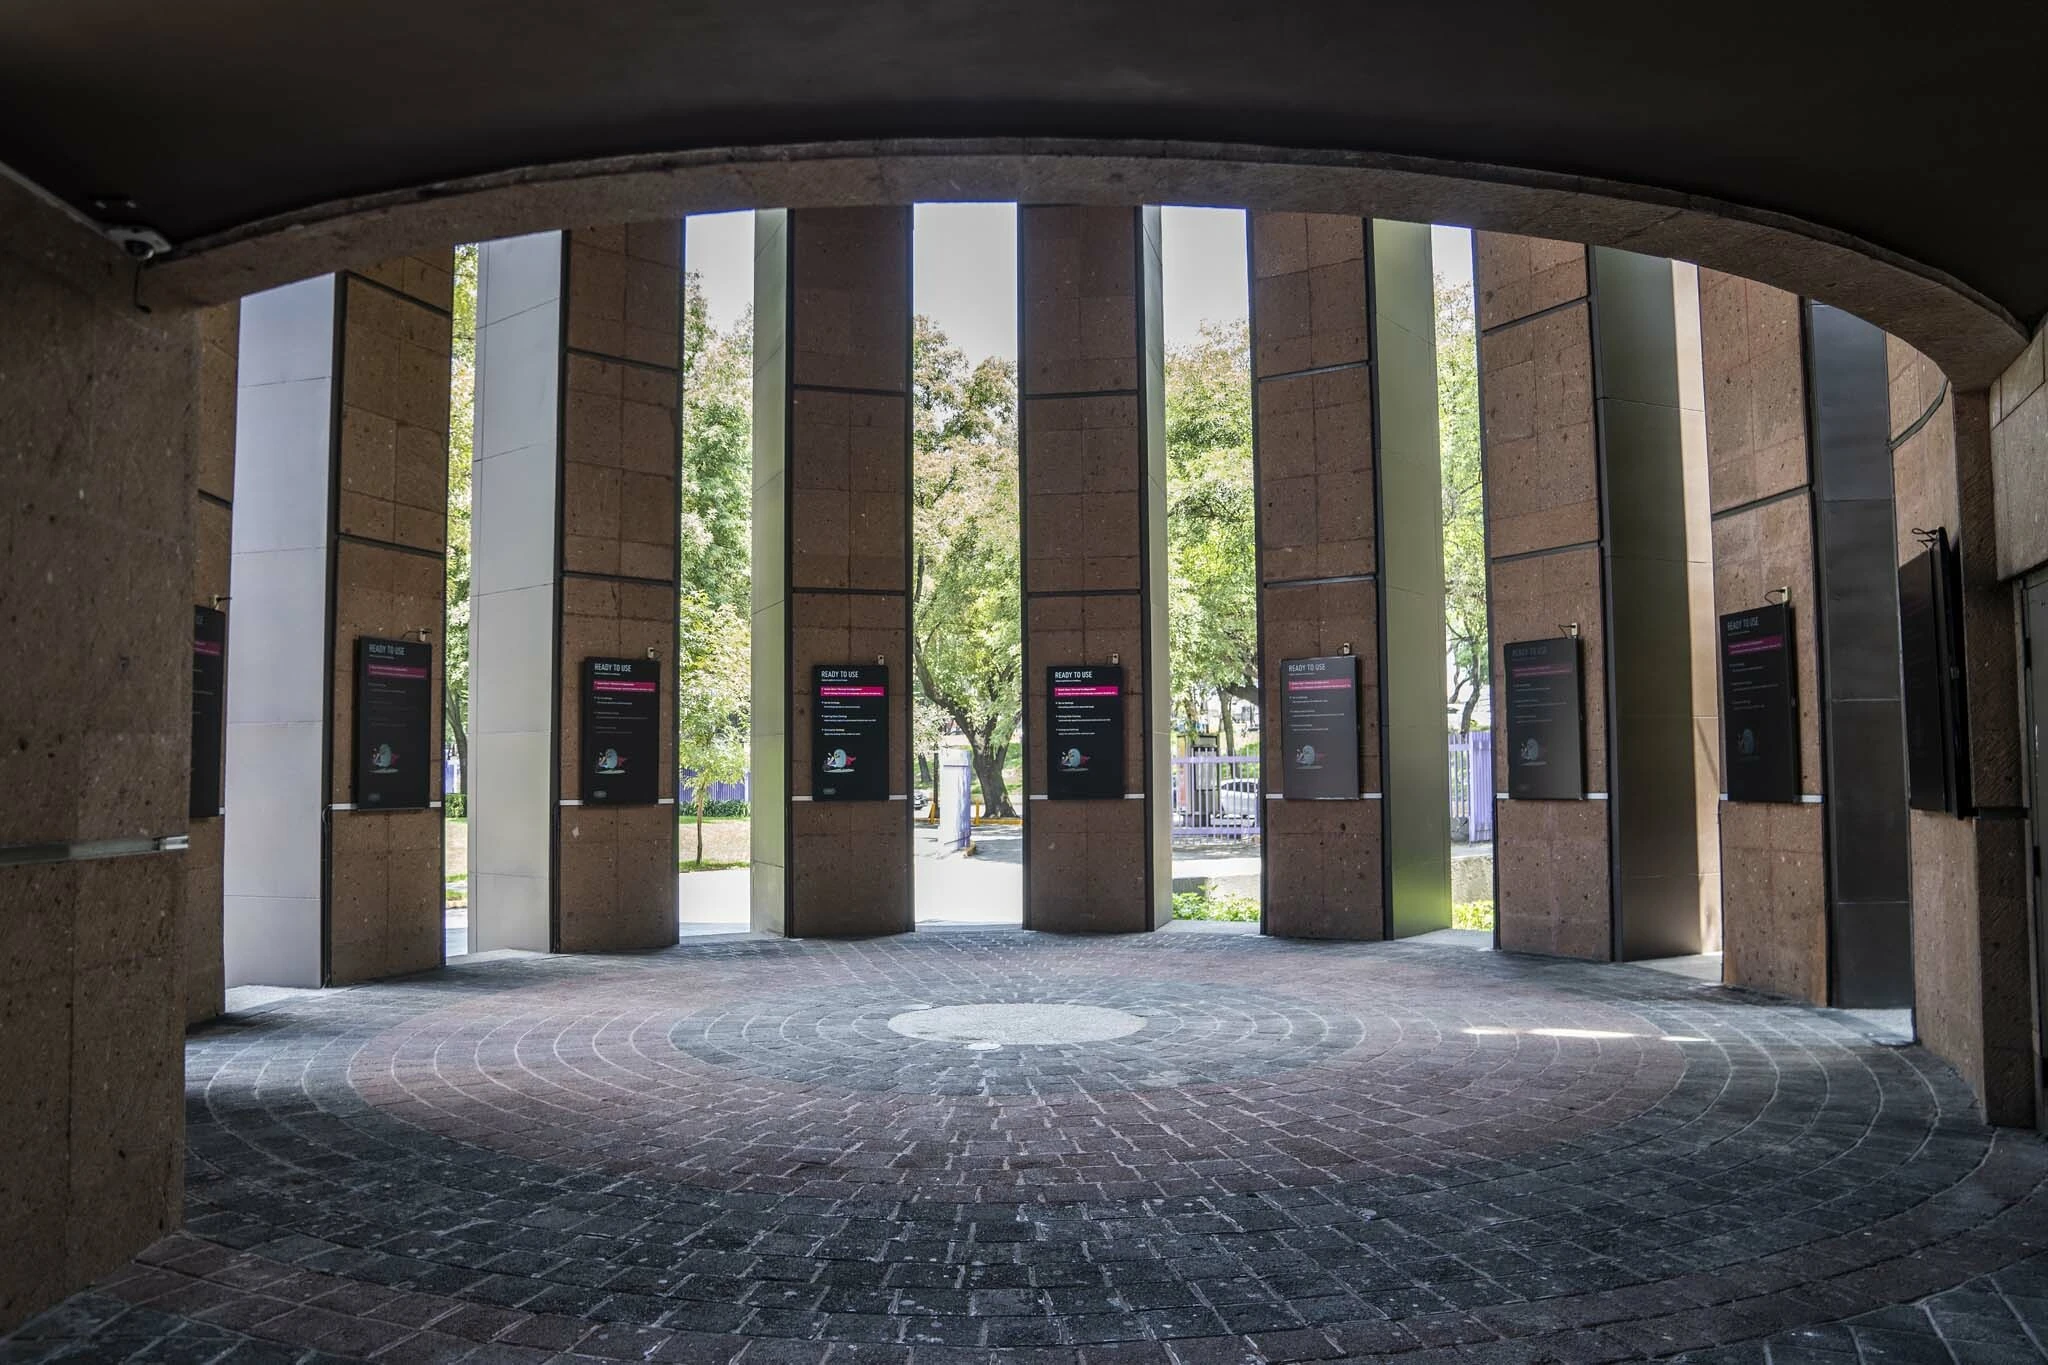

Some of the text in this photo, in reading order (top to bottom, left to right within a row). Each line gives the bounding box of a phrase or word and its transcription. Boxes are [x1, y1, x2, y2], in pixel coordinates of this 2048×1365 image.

[594, 663, 631, 672] READY TO USE
[1288, 664, 1305, 672] READY
[1315, 663, 1326, 671] USE
[1055, 671, 1072, 679] READY
[1082, 671, 1092, 679] USE
